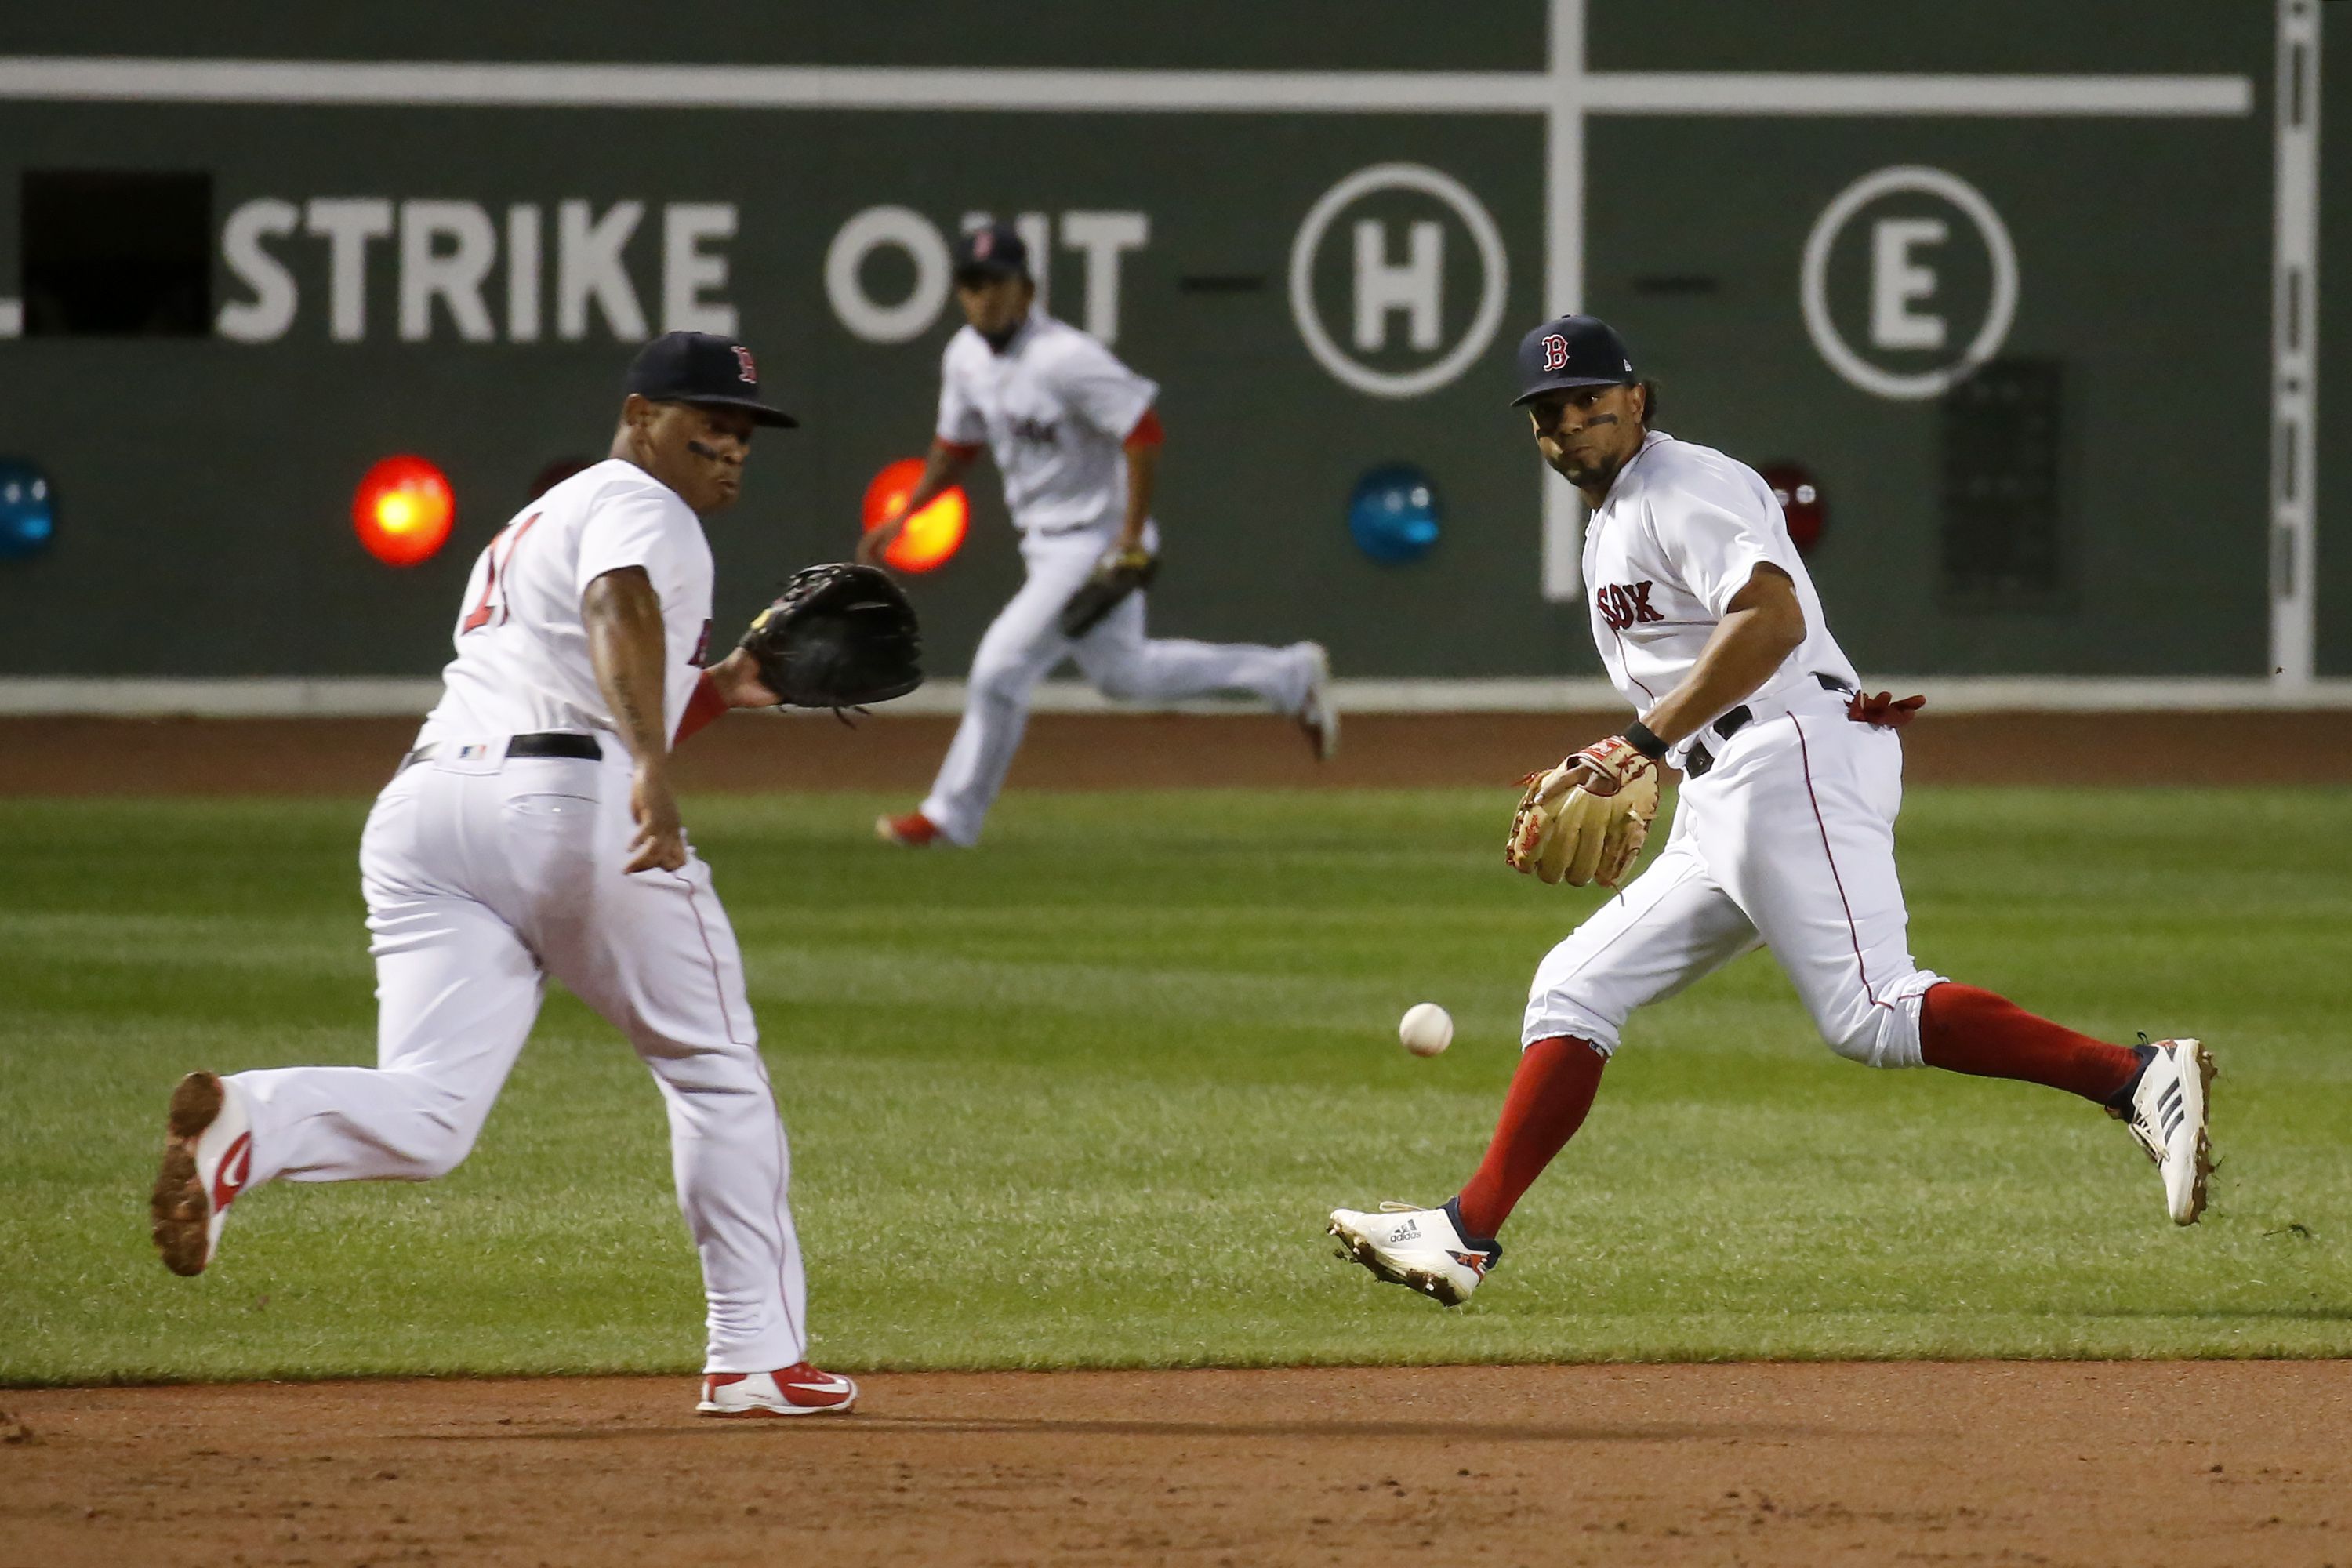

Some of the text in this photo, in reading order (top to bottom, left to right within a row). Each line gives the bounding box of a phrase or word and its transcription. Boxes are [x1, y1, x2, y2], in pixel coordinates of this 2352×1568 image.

[215, 198, 739, 341] STRIKE
[1353, 220, 1445, 351] H
[1871, 219, 1948, 350] E
[1541, 334, 1570, 372] B
[1597, 580, 1664, 630] SOX
[1390, 1231, 1421, 1243] adidas
